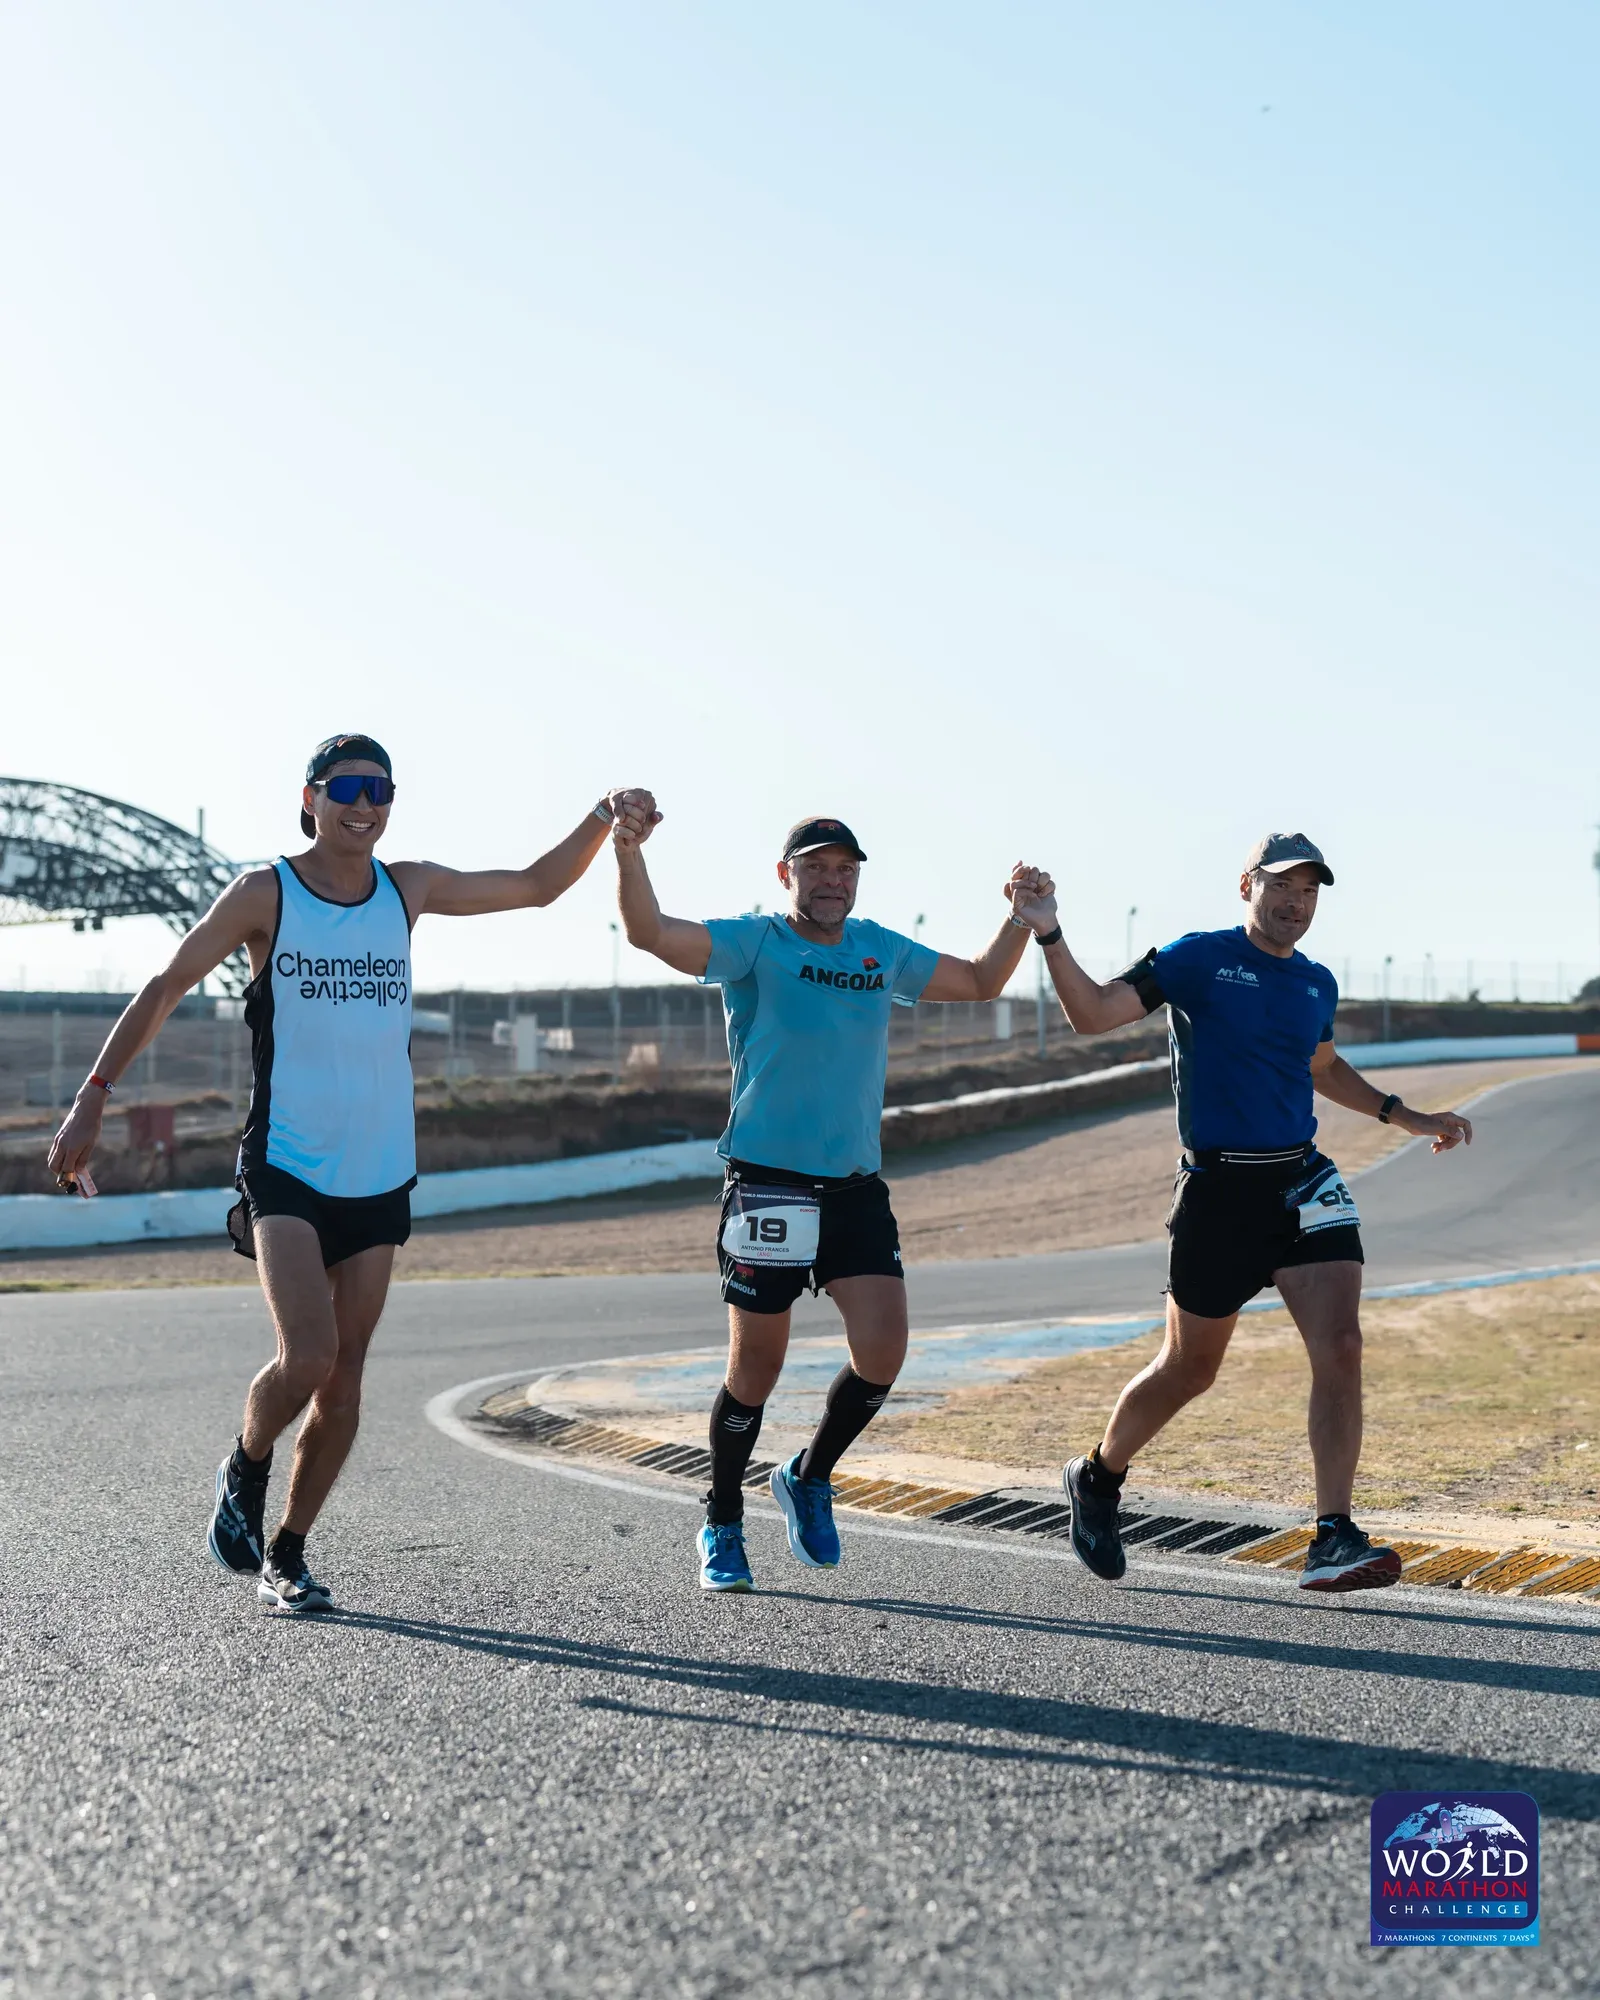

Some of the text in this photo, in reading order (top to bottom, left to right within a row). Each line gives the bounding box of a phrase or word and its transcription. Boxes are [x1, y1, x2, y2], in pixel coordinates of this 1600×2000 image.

[276, 951, 406, 978] Chameleon
[799, 964, 885, 991] ANGOLA
[300, 980, 407, 1007] Collective
[746, 1216, 788, 1244] 19
[741, 1244, 764, 1252] ANTONIO
[730, 1280, 757, 1296] ANGOLA
